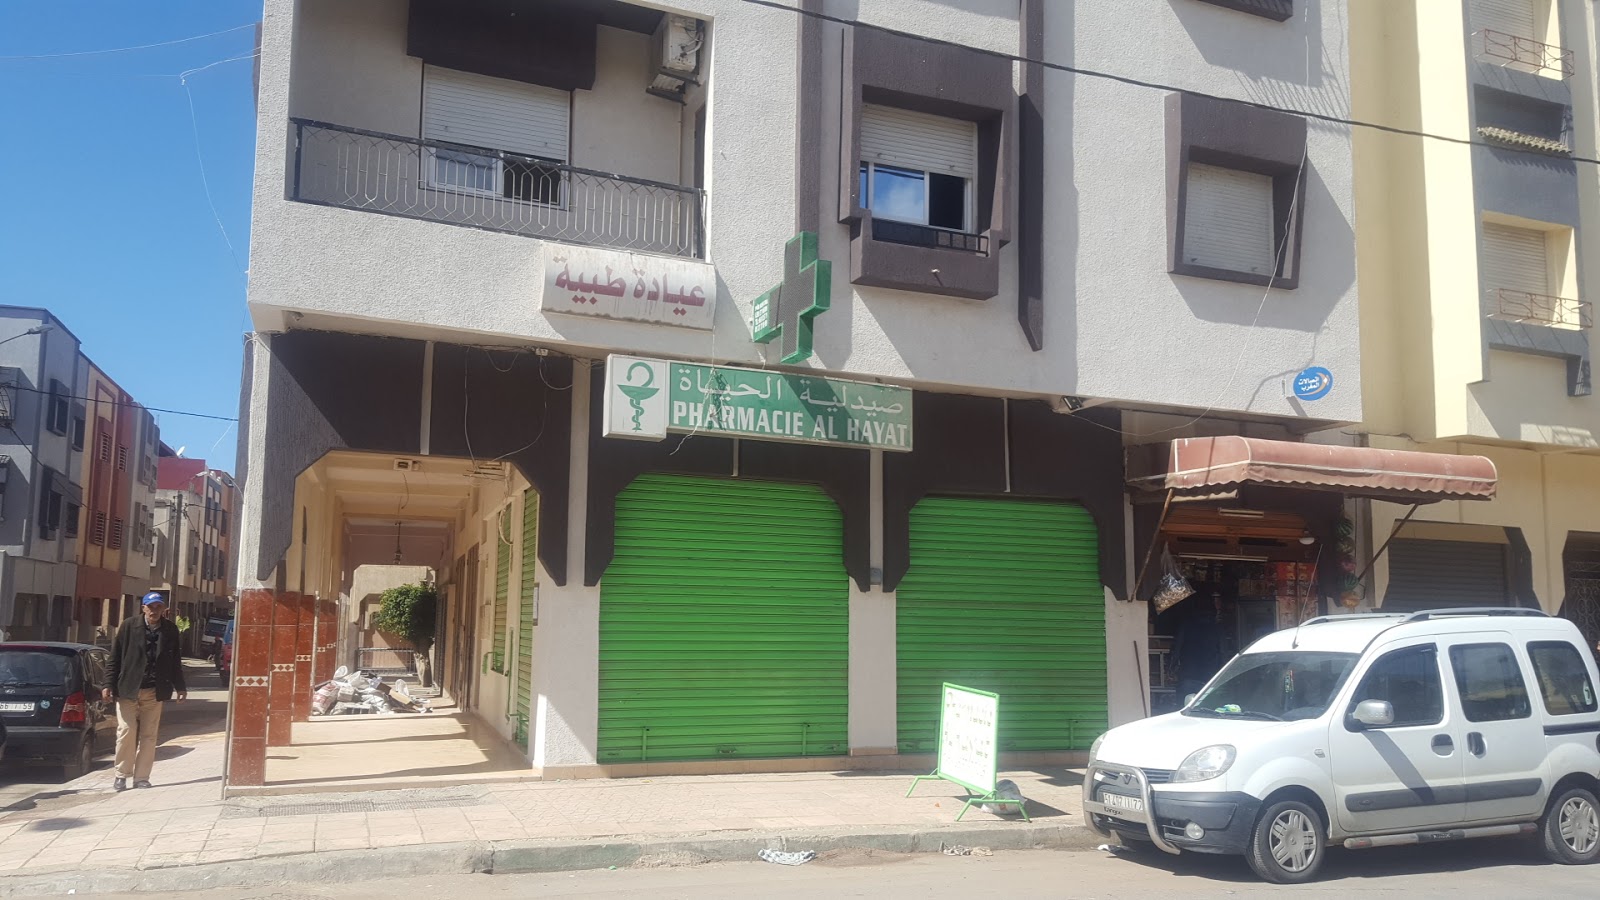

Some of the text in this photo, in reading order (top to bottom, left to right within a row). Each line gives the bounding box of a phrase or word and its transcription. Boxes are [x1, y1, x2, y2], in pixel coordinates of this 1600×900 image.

[553, 256, 627, 305] طبية
[633, 268, 706, 316] عيادة
[679, 369, 903, 417] صيدلية الحياة
[673, 401, 907, 446] PHARMACIE AL HAYAT
